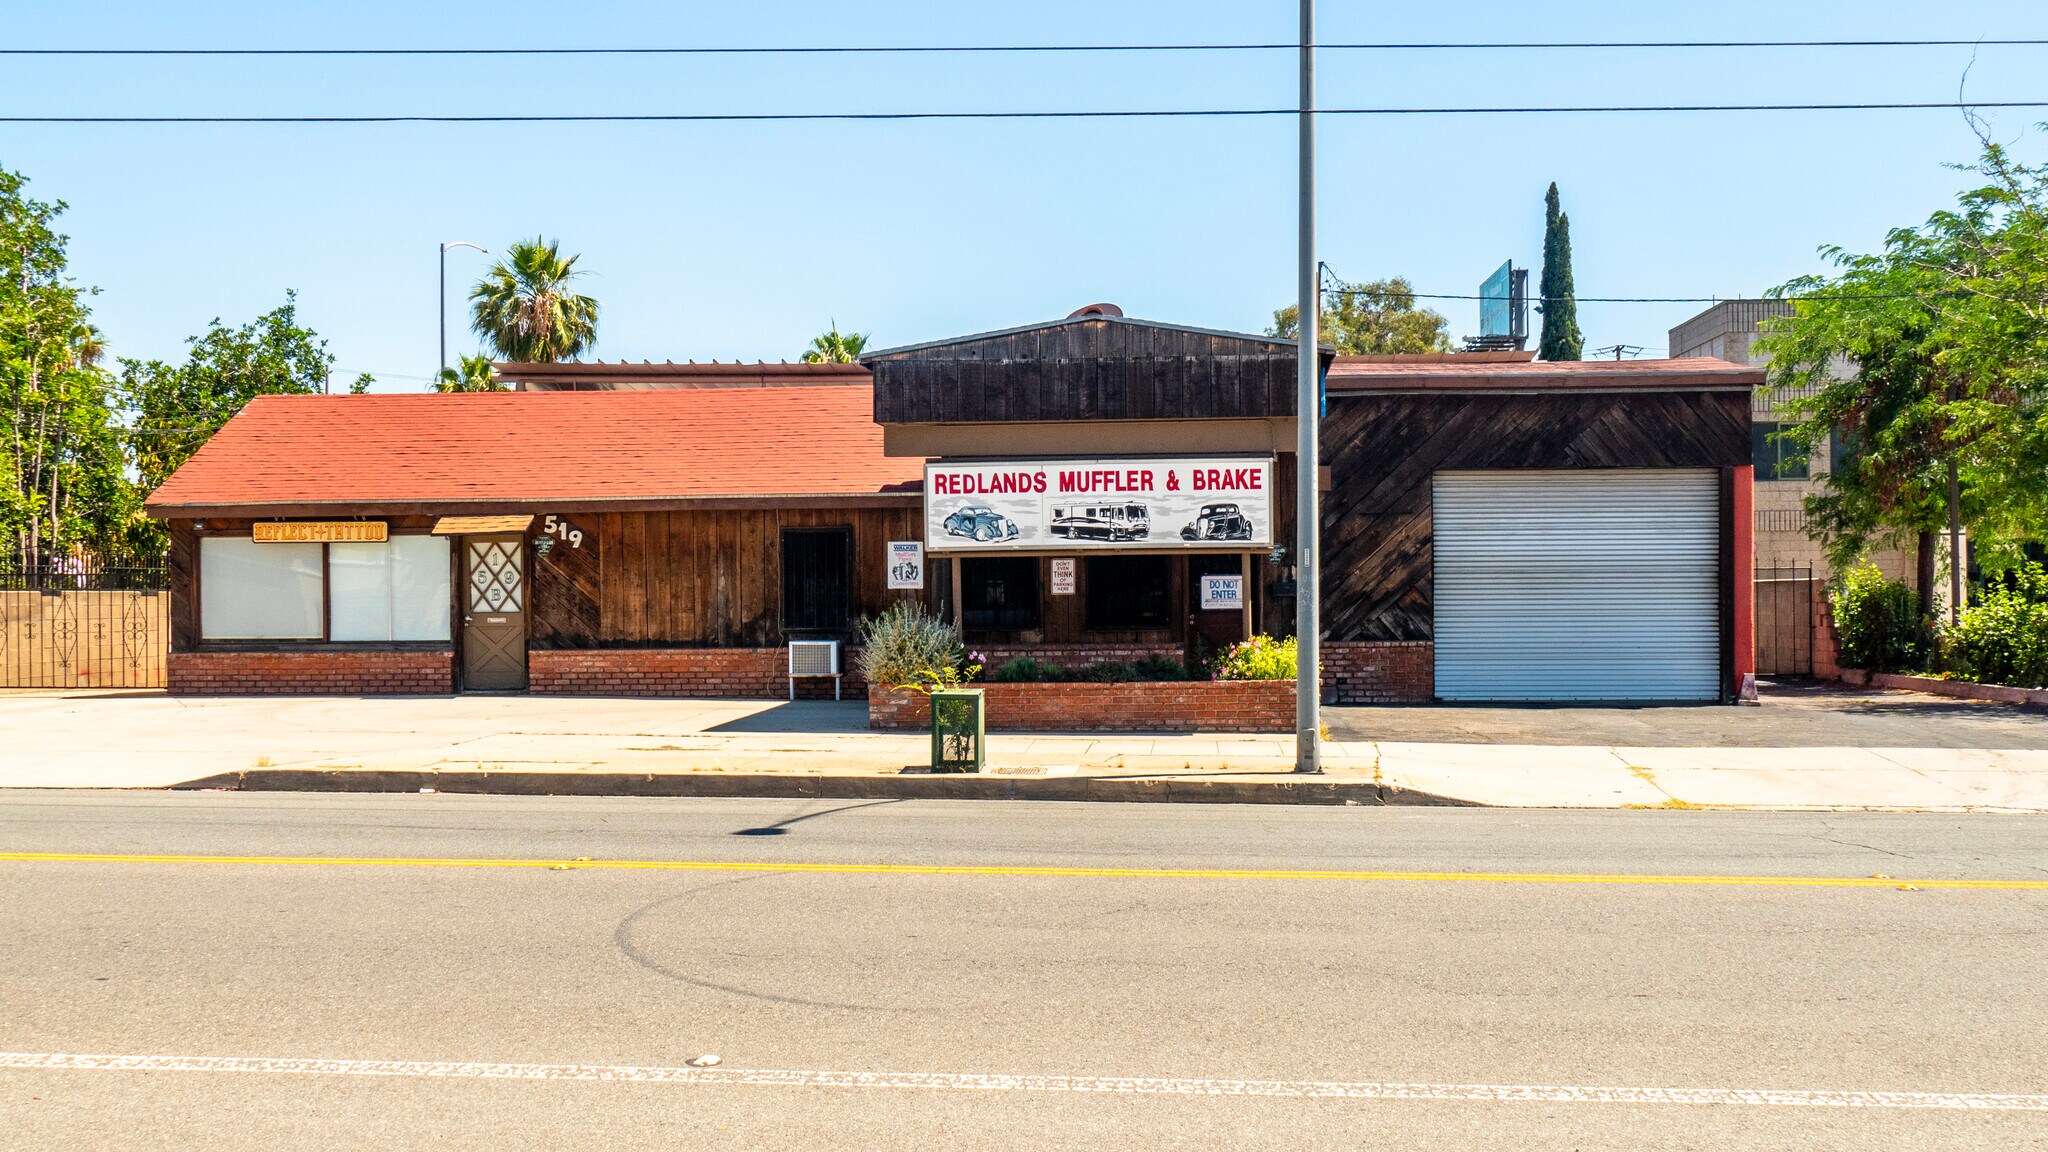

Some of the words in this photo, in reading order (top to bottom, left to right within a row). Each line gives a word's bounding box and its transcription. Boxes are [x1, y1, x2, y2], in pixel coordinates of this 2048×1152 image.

[934, 471, 1047, 494] REDLANDS
[1059, 470, 1154, 493] MUFFLER
[1166, 469, 1180, 492] &
[1192, 468, 1263, 491] BRAKE
[254, 523, 317, 541] REFLECT
[324, 523, 384, 540] TATTOO
[543, 515, 583, 549] 519
[1209, 580, 1221, 589] DO
[1222, 580, 1239, 589] NOT
[1211, 590, 1237, 599] ENTER
